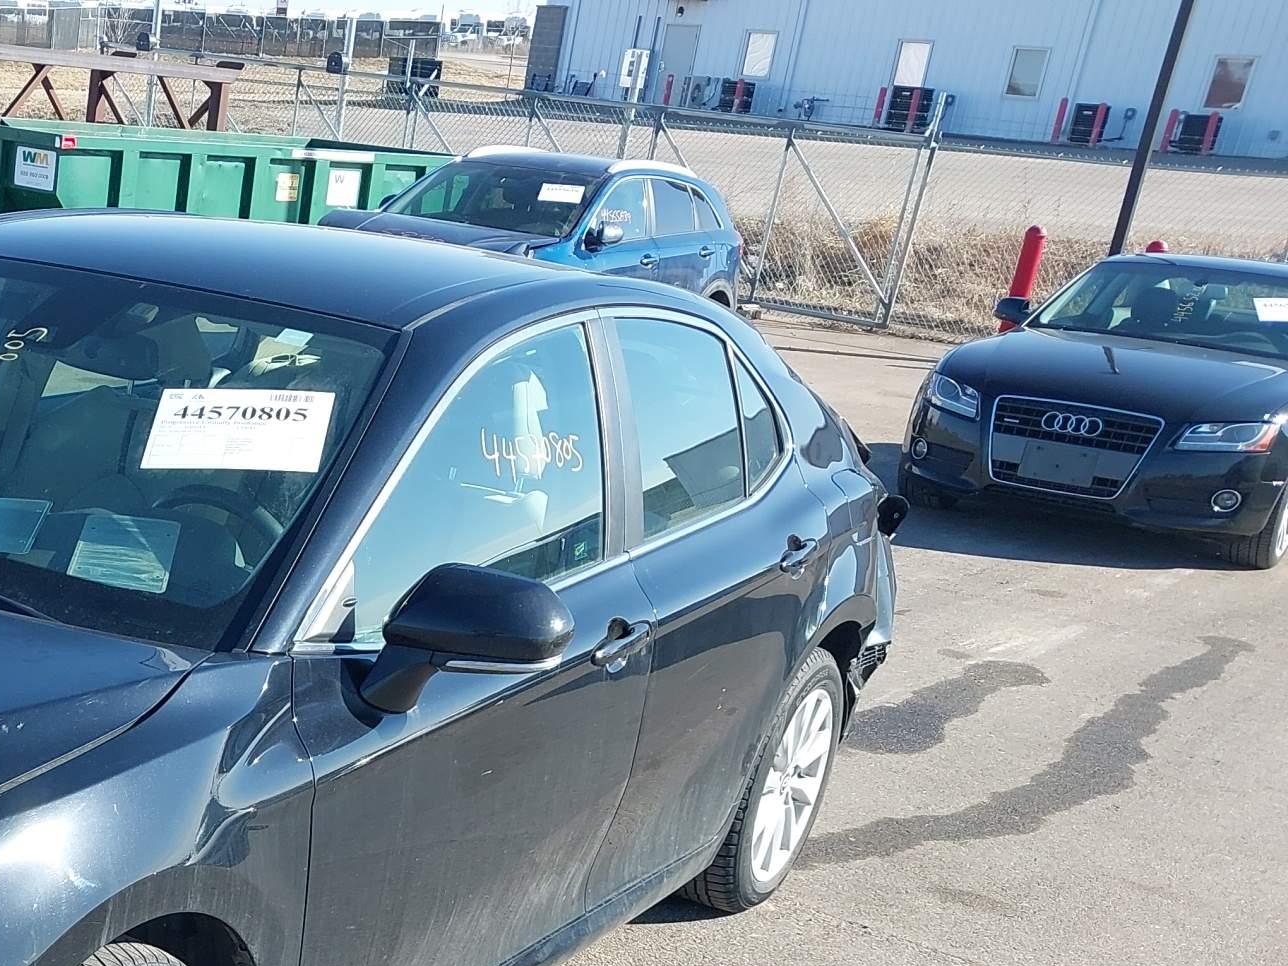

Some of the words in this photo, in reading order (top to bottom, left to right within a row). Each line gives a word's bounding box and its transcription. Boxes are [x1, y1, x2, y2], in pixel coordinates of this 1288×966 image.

[22, 150, 50, 166] WM
[173, 405, 309, 422] 44570805
[480, 427, 585, 483] 44570805
